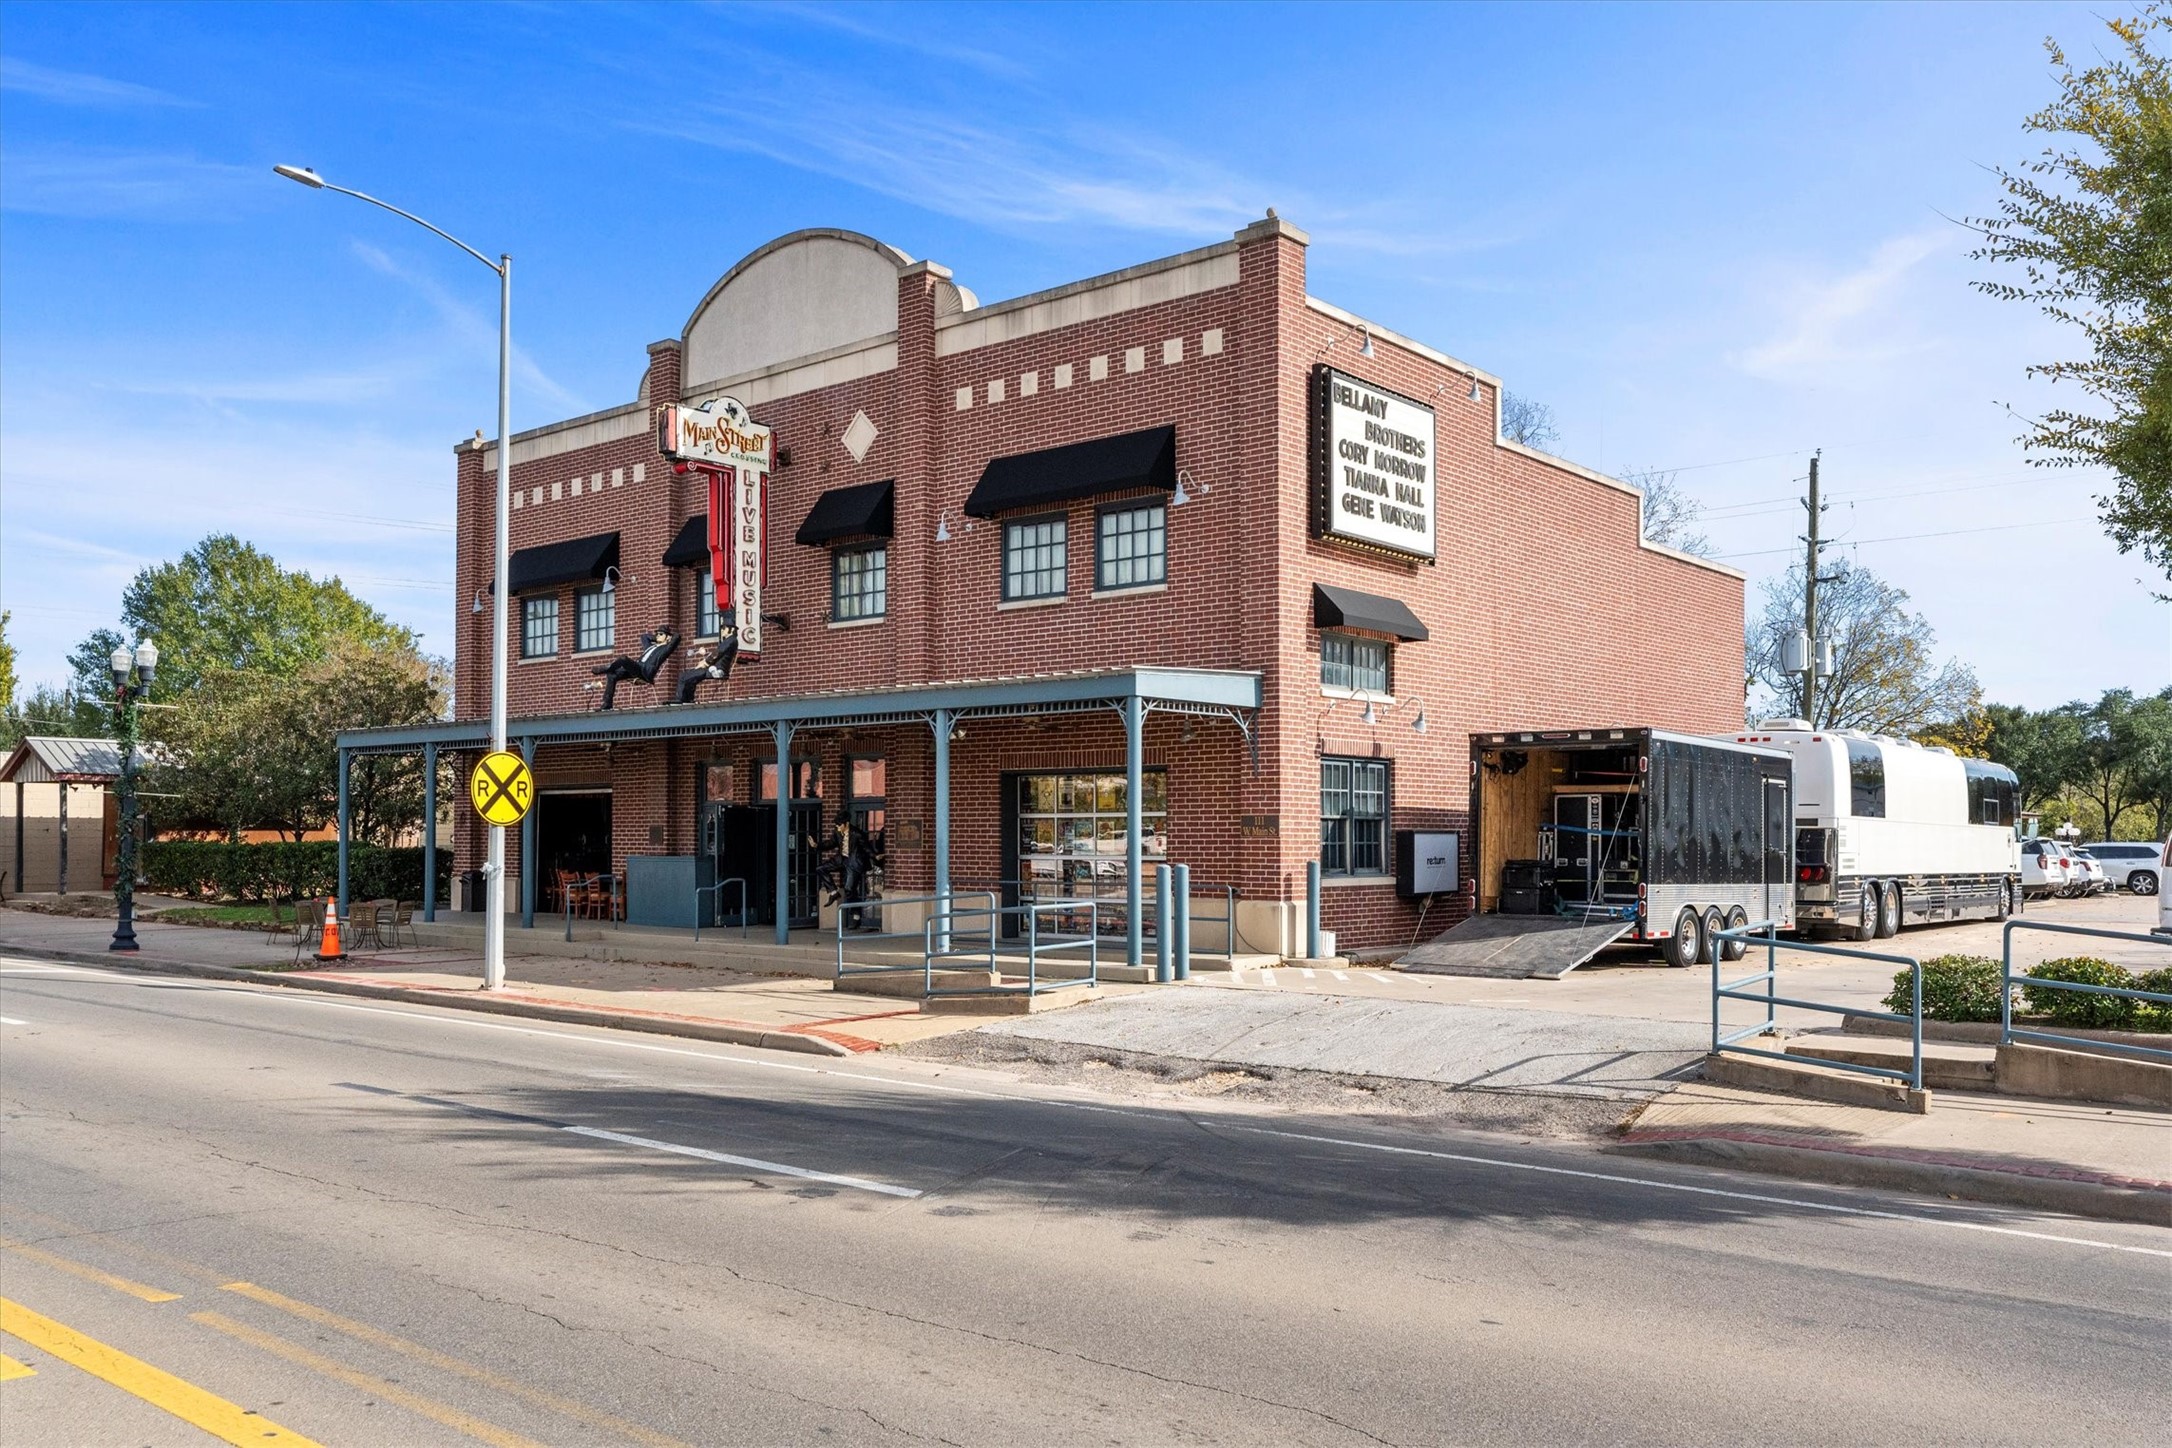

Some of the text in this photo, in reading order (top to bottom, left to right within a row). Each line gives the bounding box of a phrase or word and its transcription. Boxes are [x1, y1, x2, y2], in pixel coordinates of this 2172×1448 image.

[1333, 382, 1388, 420] BELLAMY
[1338, 438, 1426, 483] CORY MORROW
[1365, 420, 1426, 459] BROTHERS
[743, 469, 756, 543] LIVE
[1344, 465, 1424, 508] TIANNA HALL
[1342, 492, 1426, 533] GENE WATSON
[742, 551, 756, 645] MUSIC
[478, 780, 528, 798] R R
